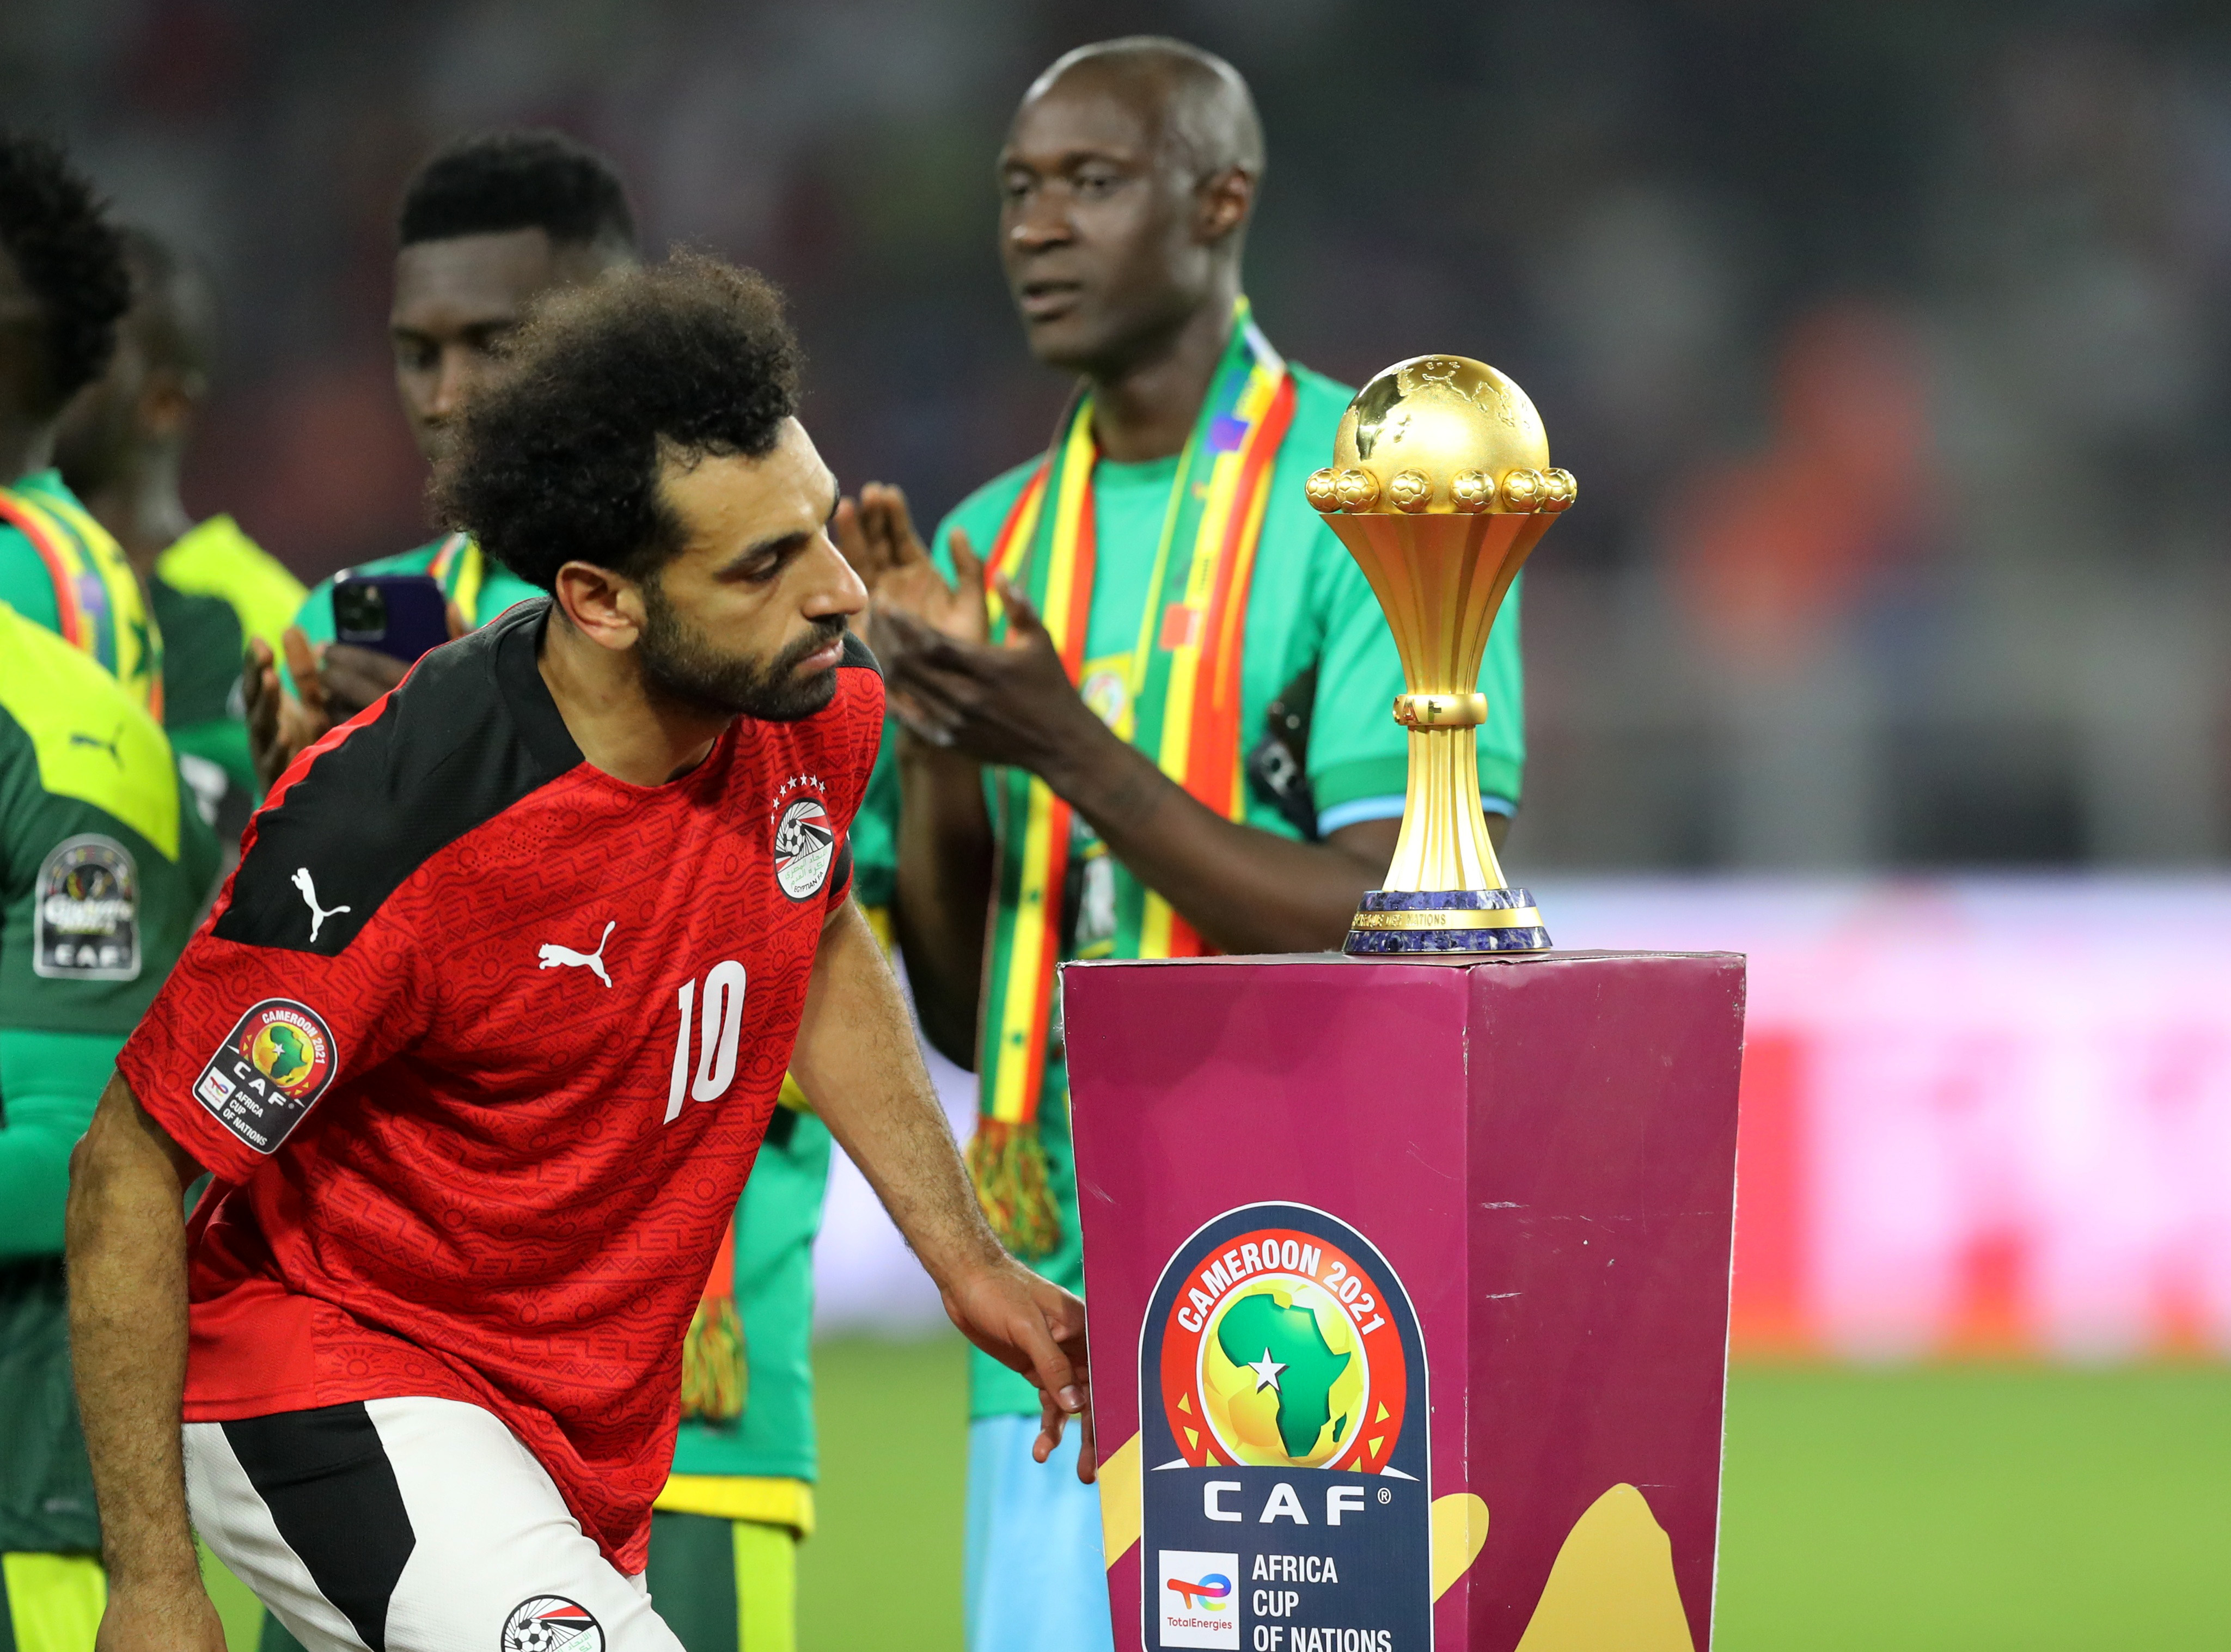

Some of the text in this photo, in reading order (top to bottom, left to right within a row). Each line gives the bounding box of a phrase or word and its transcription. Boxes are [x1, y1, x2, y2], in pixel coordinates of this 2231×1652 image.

[794, 872, 823, 892] EGYPTIAN FA
[1406, 914, 1446, 926] NATIONS
[262, 1010, 326, 1064] CAMEROON 2021
[663, 960, 746, 1125] 10
[234, 1061, 286, 1106] CAF
[229, 1099, 246, 1115] CUP
[235, 1091, 264, 1117] AFRICA
[223, 1108, 267, 1146] OF NATIONS
[1177, 1239, 1385, 1336] CAMEROON 2021
[1203, 1480, 1365, 1526] CAF
[1252, 1554, 1338, 1583] AFRICA
[1253, 1589, 1299, 1617] CUP
[1167, 1617, 1232, 1631] TotalEnergies
[1253, 1625, 1392, 1652] OF NATIONS
